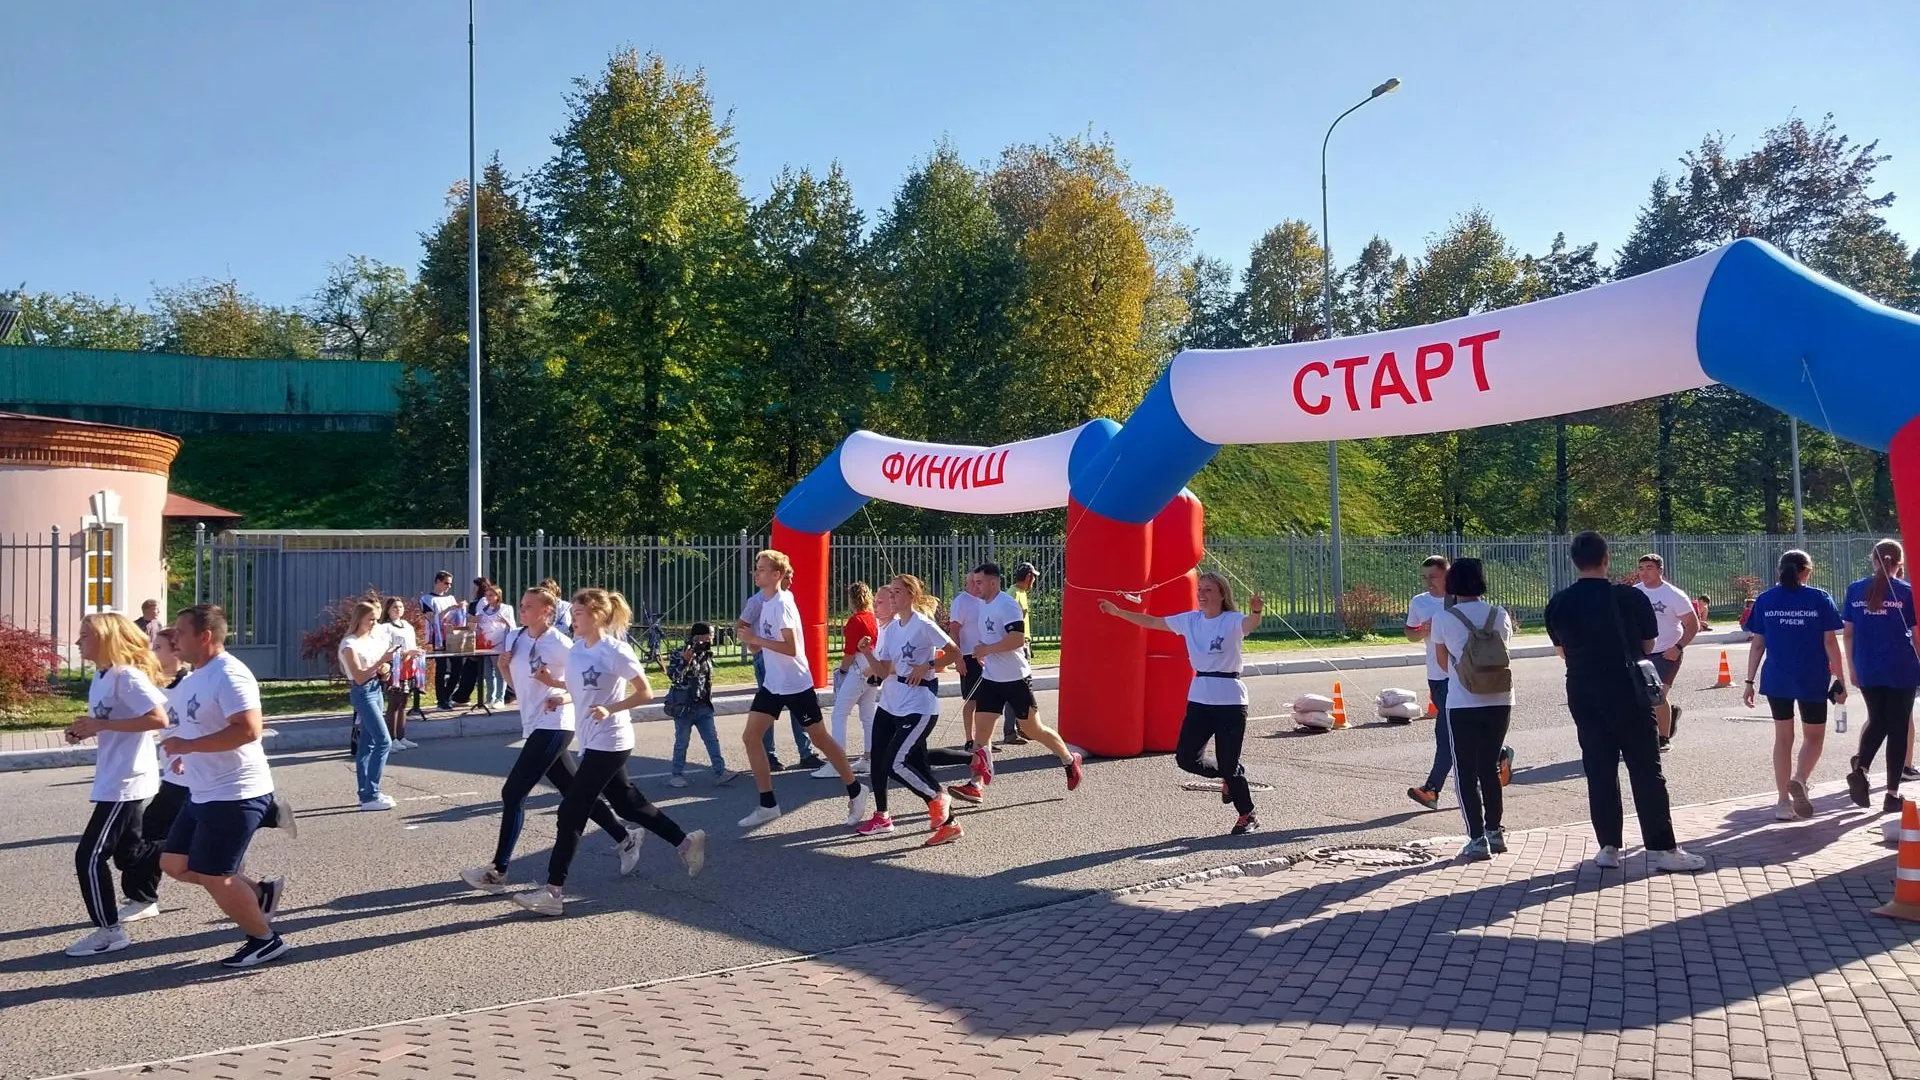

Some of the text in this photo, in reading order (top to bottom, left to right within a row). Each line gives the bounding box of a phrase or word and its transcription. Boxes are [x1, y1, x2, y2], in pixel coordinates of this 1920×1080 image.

[1293, 330, 1500, 415] СТАРТ
[882, 450, 1009, 490] ФИНИШ
[1851, 600, 1903, 609] КОЛОСКИЙ
